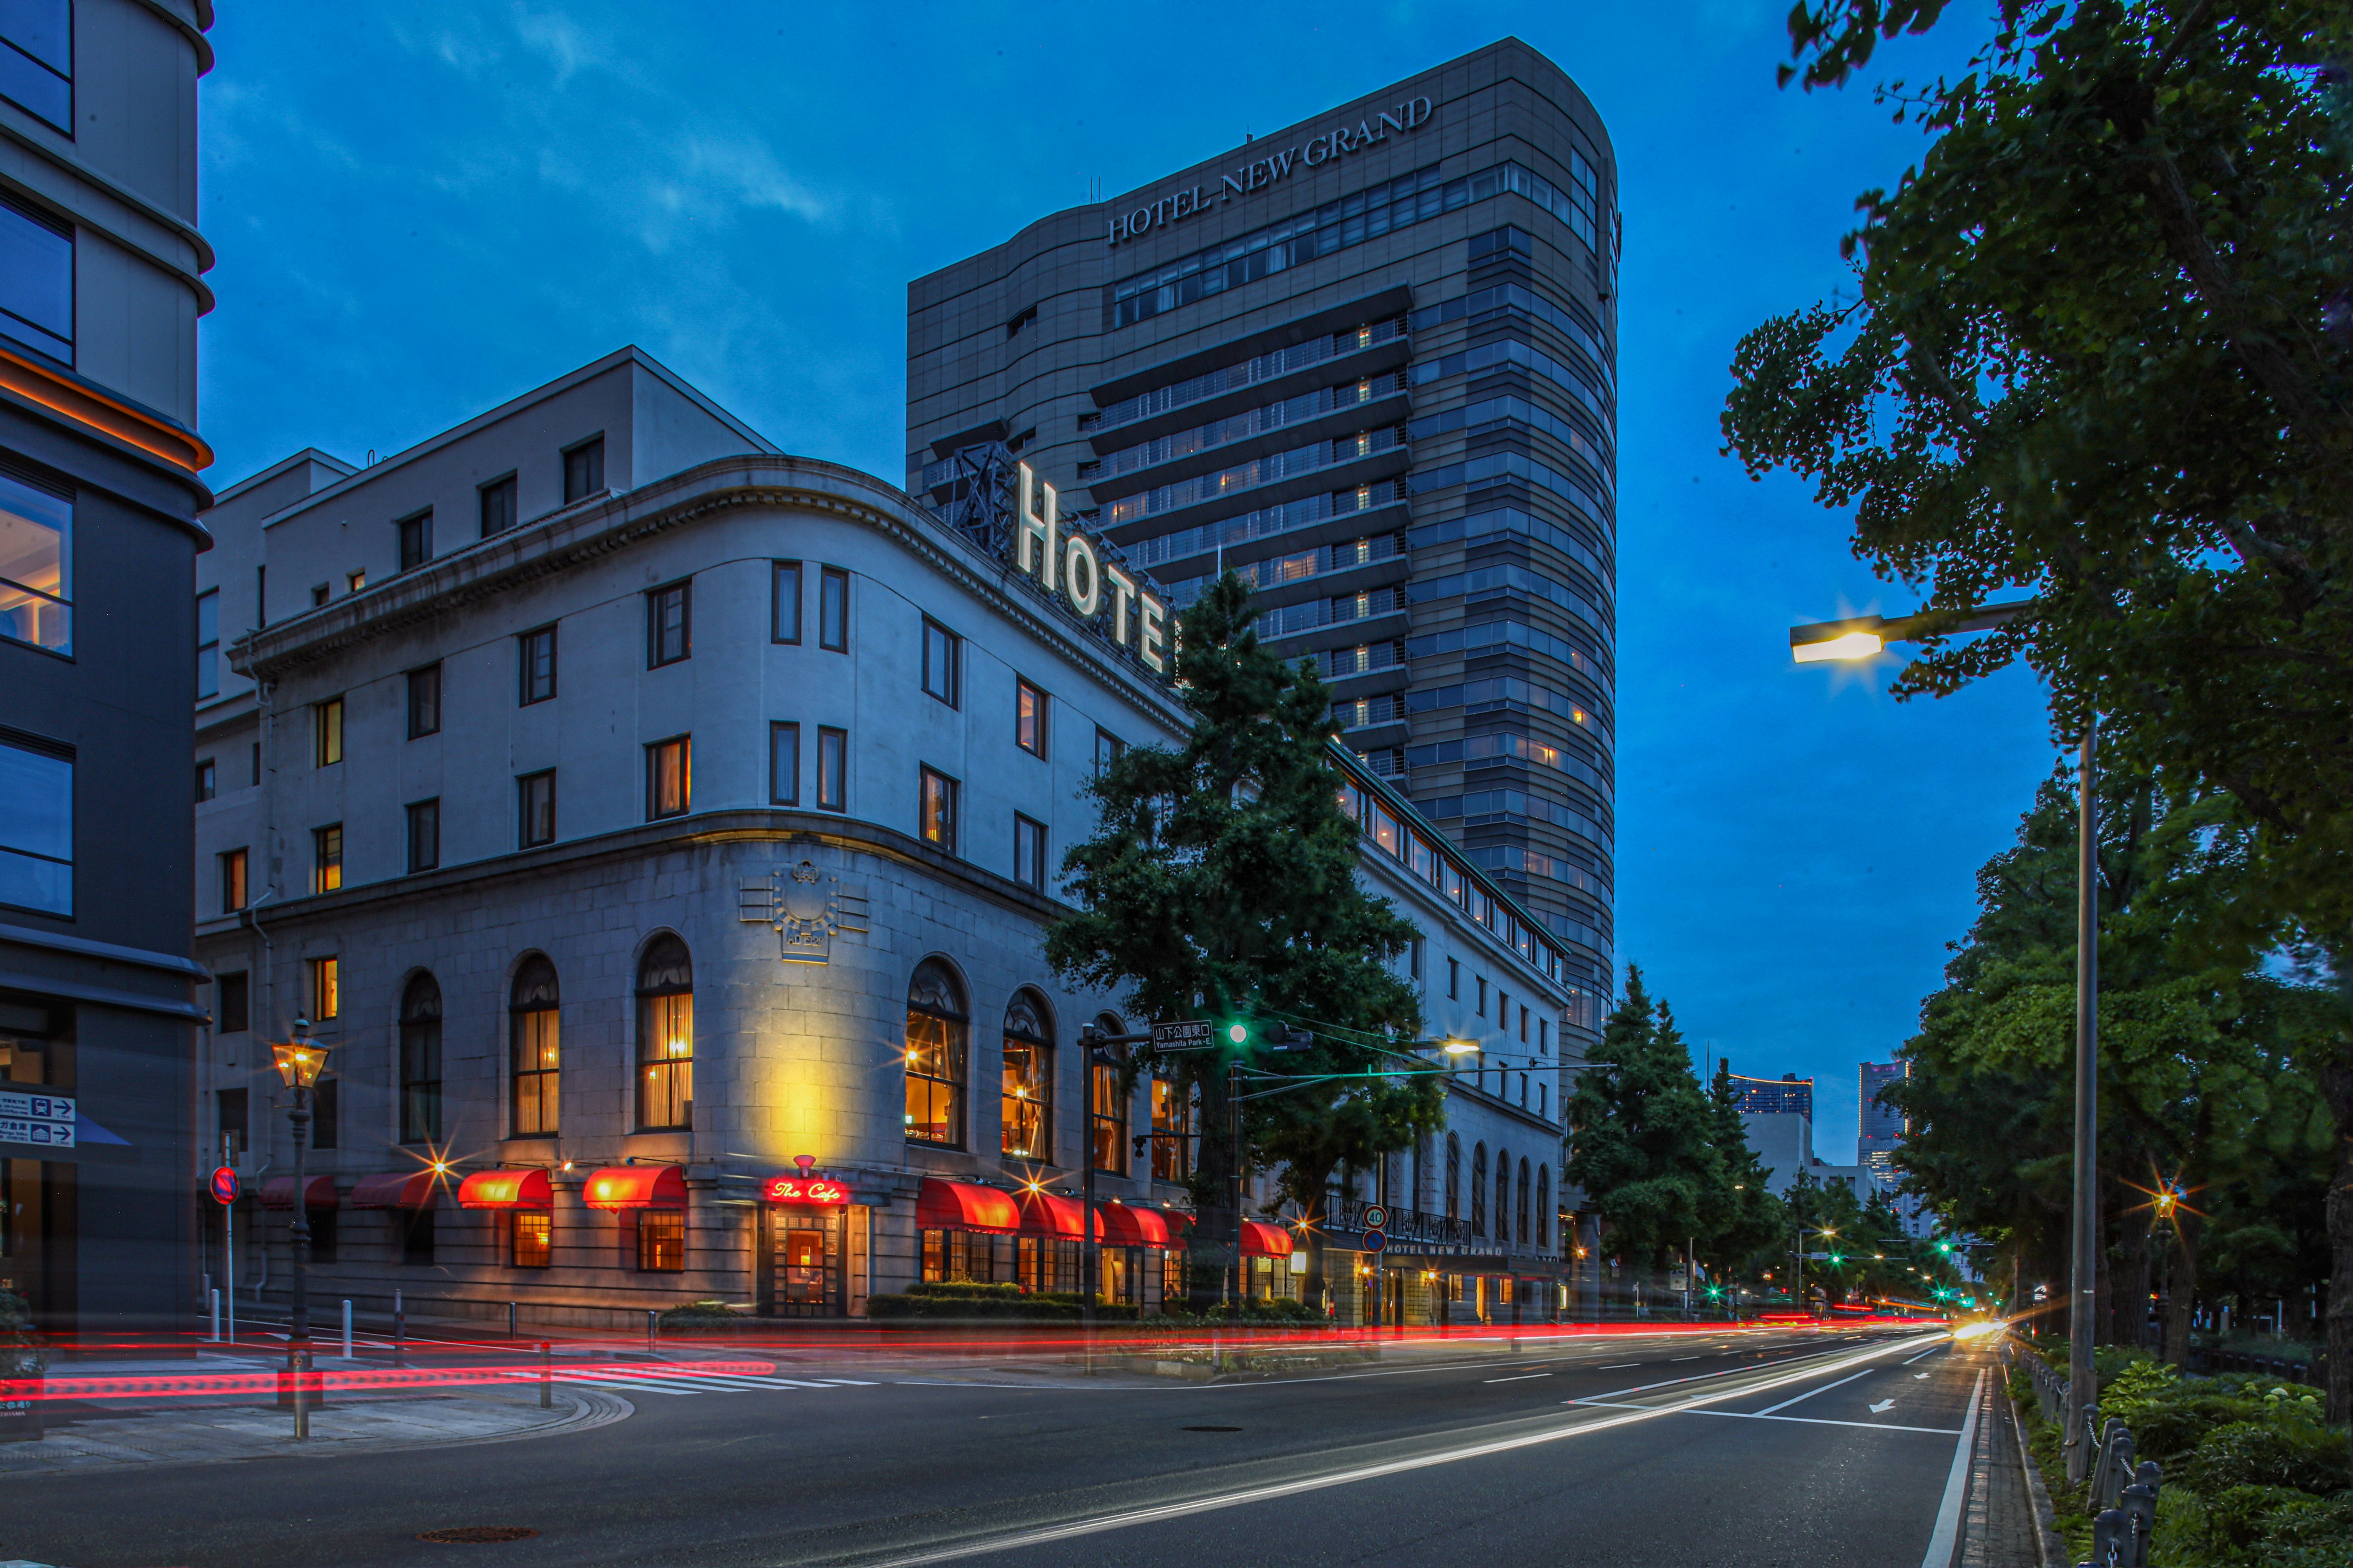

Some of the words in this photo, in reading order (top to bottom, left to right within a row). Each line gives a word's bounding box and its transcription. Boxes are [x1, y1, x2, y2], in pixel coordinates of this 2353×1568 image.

[1108, 185, 1211, 246] HOTEL
[1221, 147, 1298, 201] NEW
[1304, 97, 1432, 166] GRAND
[1156, 1024, 1210, 1040] 山下公園東口
[1156, 1040, 1186, 1049] Yamashita
[772, 1183, 801, 1197] The
[808, 1183, 841, 1202] Cafe
[1369, 1212, 1382, 1222] 40
[1386, 1244, 1424, 1254] HOTEL
[1429, 1245, 1455, 1255] NEW
[1461, 1246, 1502, 1256] GRAND
